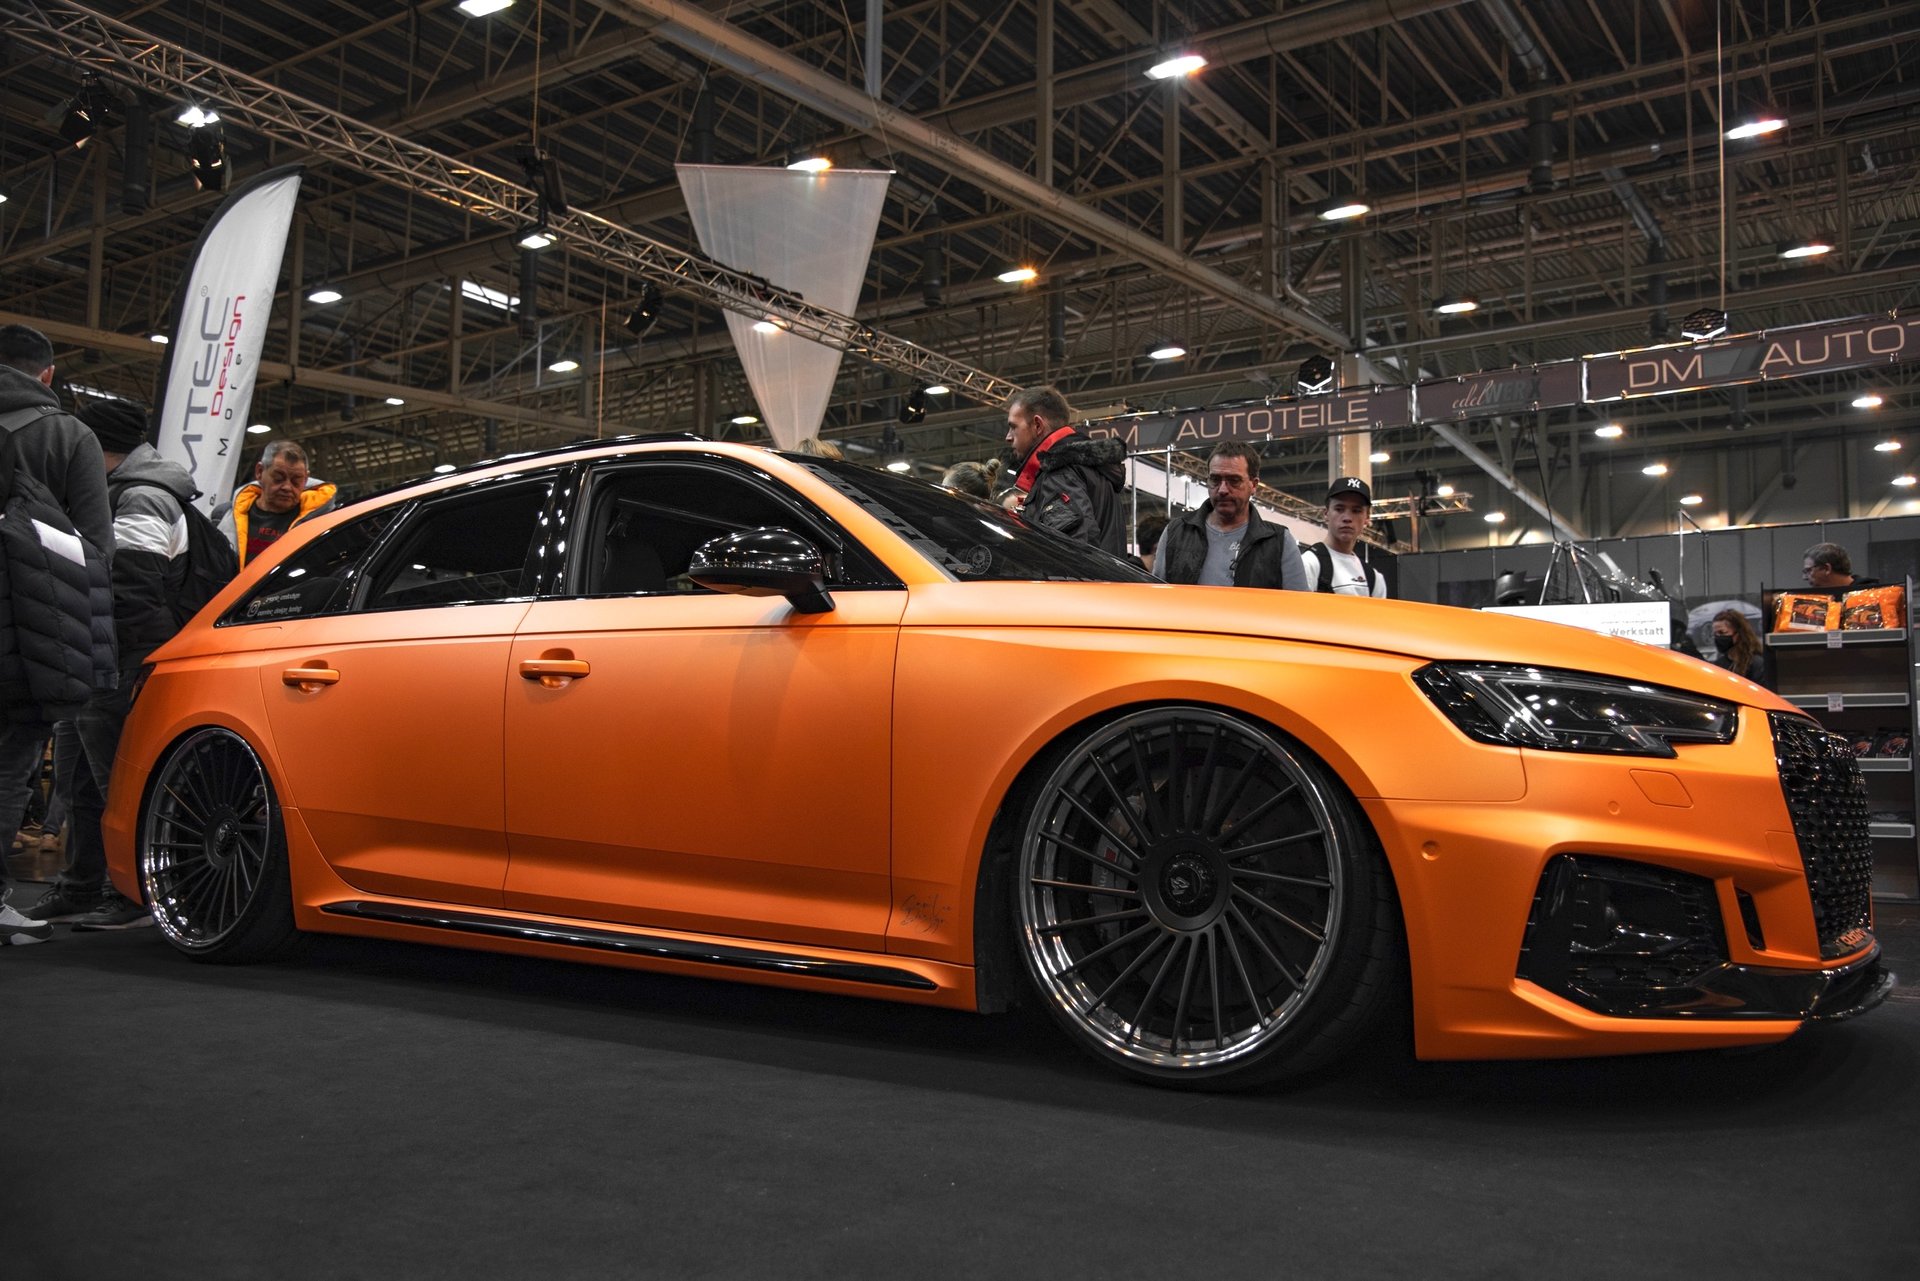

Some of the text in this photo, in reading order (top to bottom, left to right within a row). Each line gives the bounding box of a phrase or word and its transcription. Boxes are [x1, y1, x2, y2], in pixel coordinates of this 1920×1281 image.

[210, 296, 246, 417] Design
[1629, 320, 1920, 388] DM AUTO
[1176, 397, 1369, 442] AUTOTEILE
[1608, 627, 1664, 636] Werkstatt
